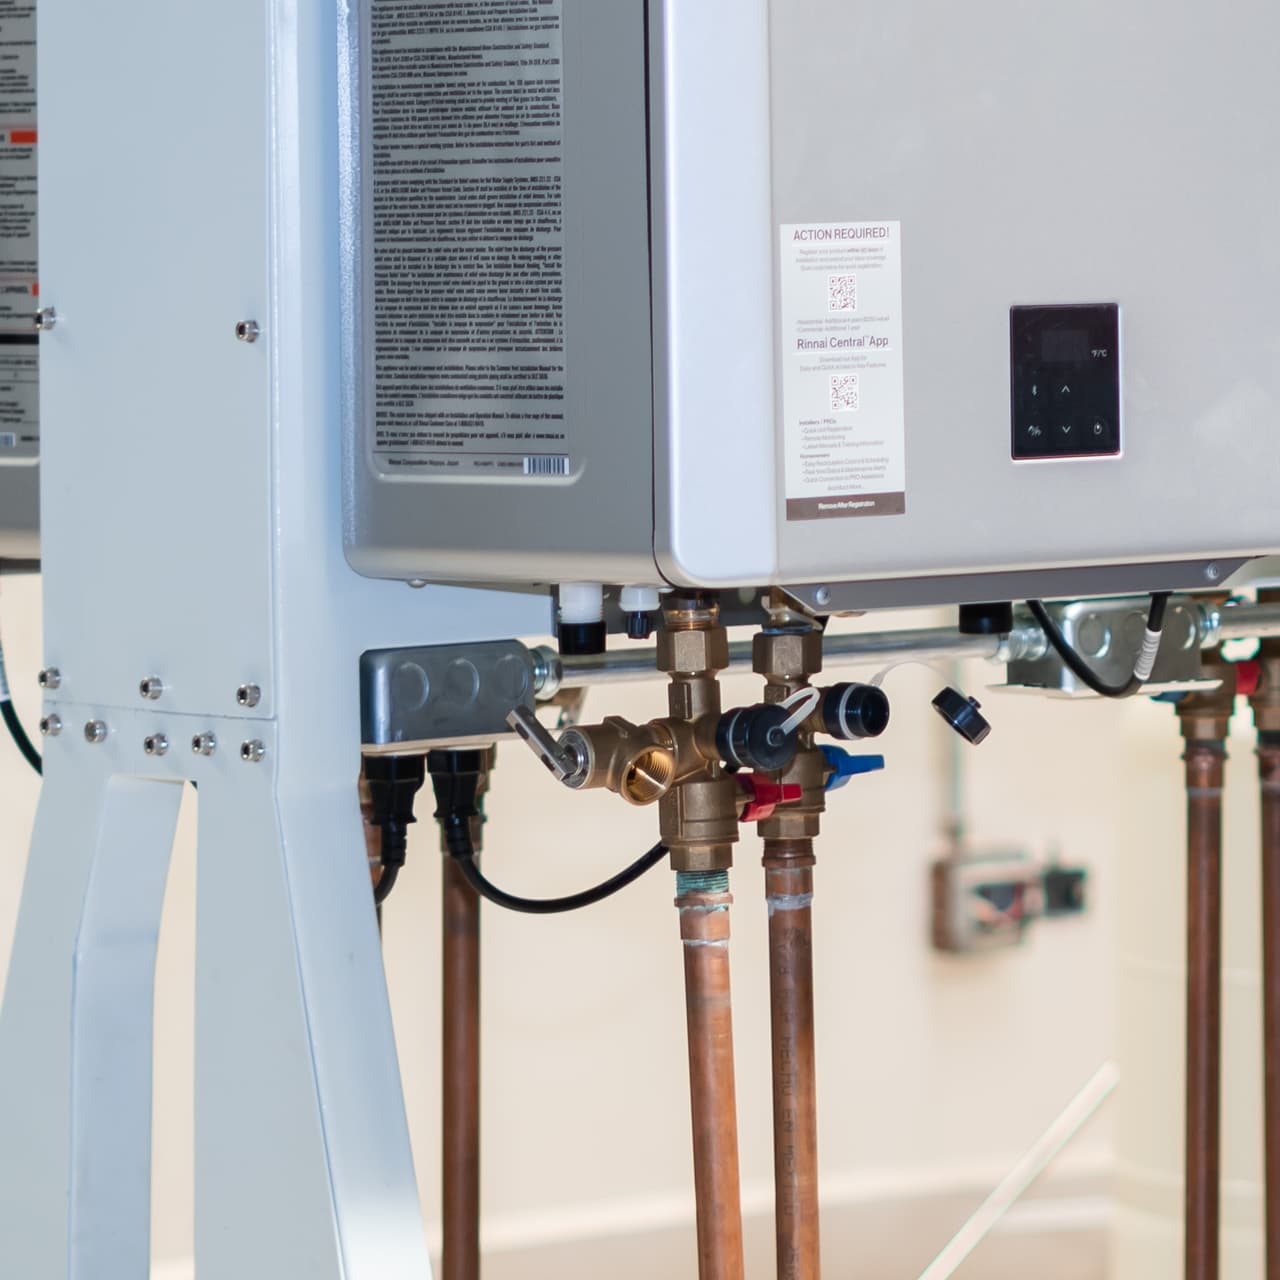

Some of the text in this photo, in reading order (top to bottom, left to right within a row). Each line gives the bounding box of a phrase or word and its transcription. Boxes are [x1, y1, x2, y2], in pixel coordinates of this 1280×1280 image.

[793, 226, 889, 240] ACTION REQUIRED!
[797, 337, 828, 350] Rinnai
[869, 335, 889, 349] App
